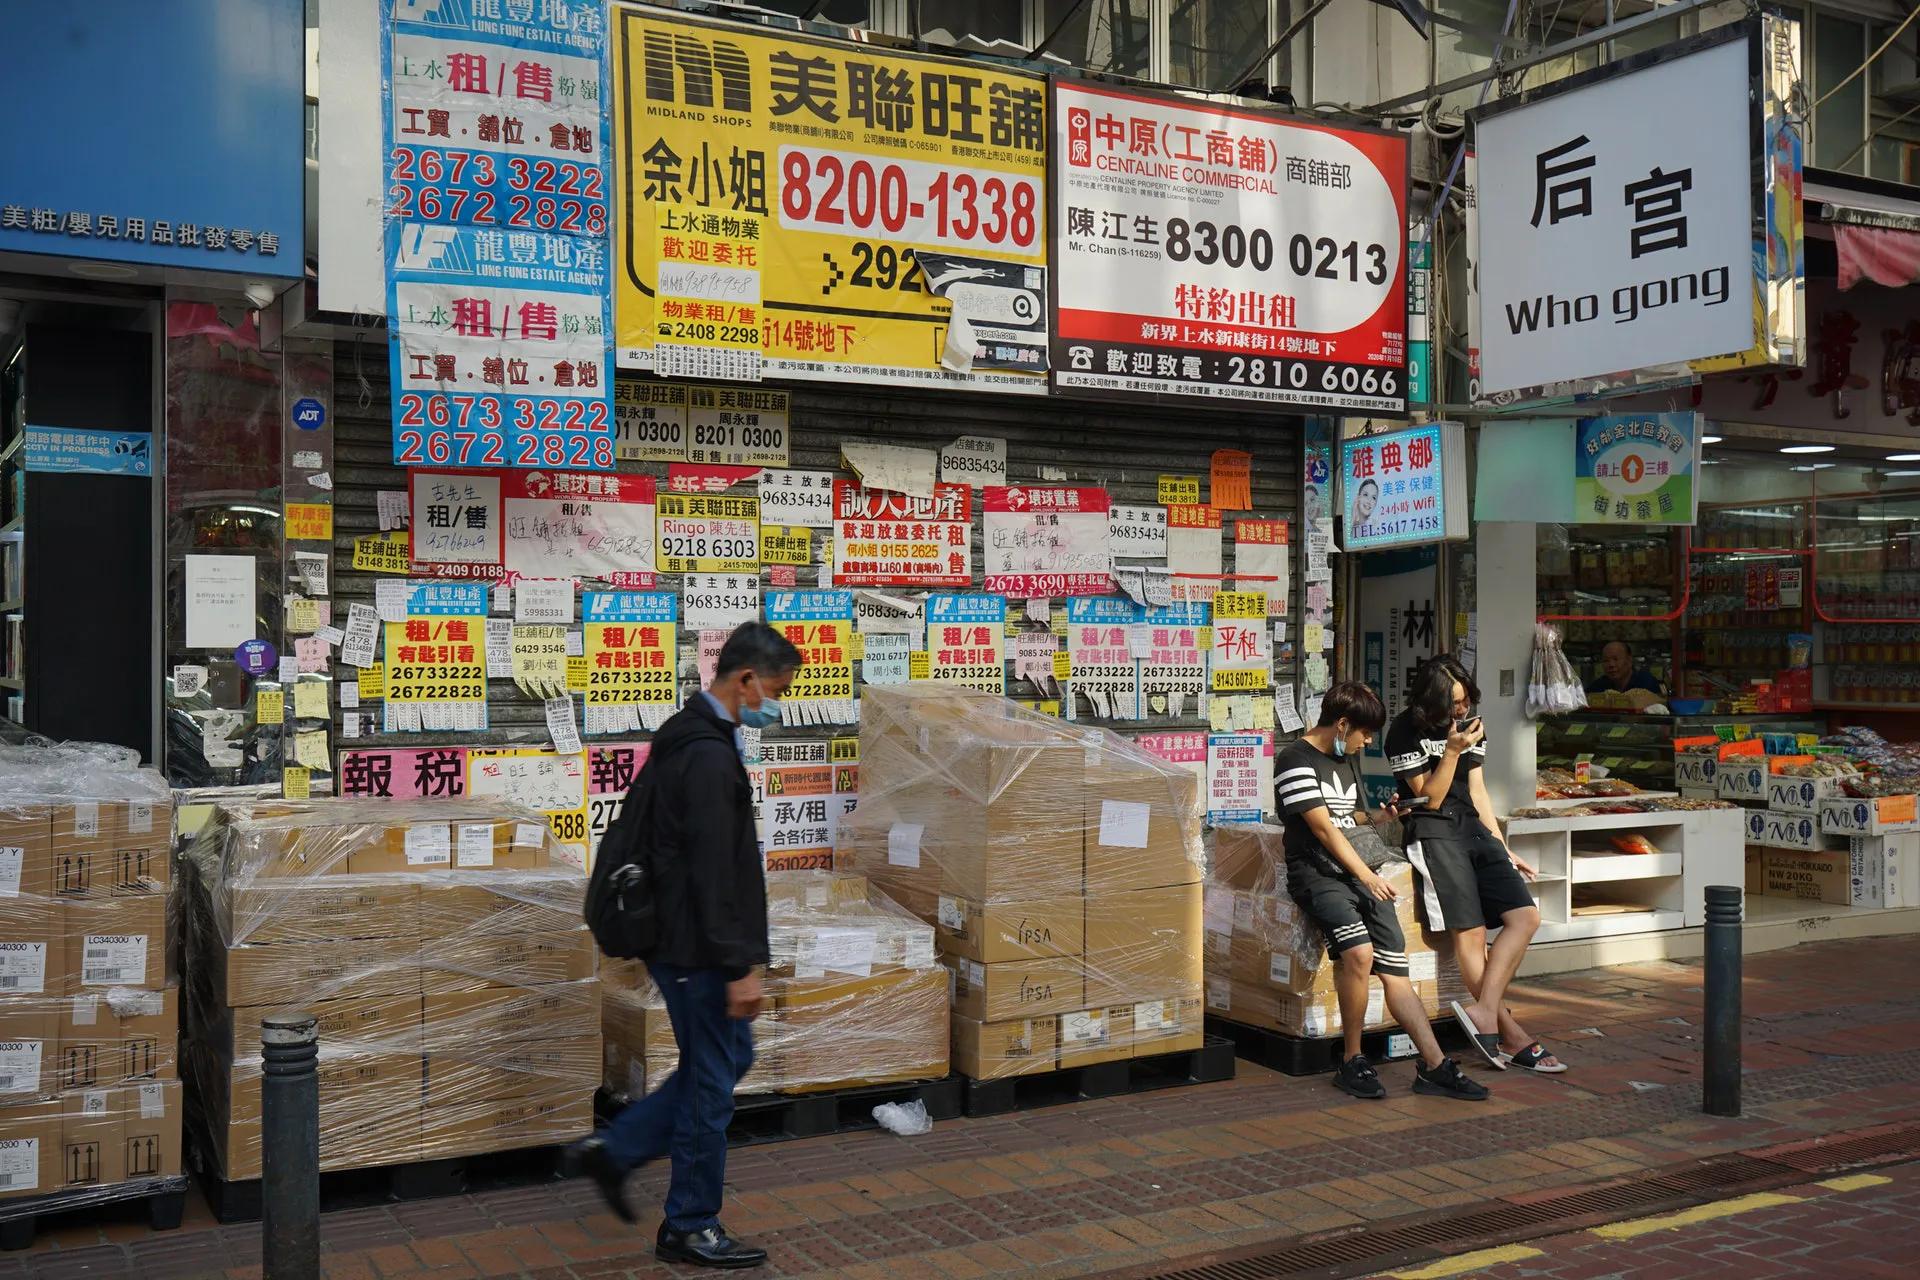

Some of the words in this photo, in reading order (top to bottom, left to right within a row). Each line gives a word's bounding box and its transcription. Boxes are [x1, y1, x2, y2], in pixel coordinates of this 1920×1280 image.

[472, 20, 498, 35] LUNG
[500, 24, 524, 38] FUNG
[526, 27, 562, 44] ESTATE
[564, 35, 601, 49] AGENCY
[647, 106, 705, 122] MIDLAND
[712, 115, 752, 128] SHOPS
[390, 148, 496, 186] 2673
[508, 158, 603, 200] 3222
[642, 136, 768, 217] 余小姐
[1097, 154, 1178, 180] CENTALINE
[1183, 166, 1278, 195] COMMERCIAL
[1100, 175, 1136, 186] CENTALINE
[1137, 180, 1170, 191] PROPERTY
[1172, 185, 1198, 195] AGENCY
[1200, 188, 1224, 198] LIMITED
[781, 151, 1036, 247] 8200-1338
[389, 185, 495, 225] 2672
[509, 195, 606, 235] 2828
[661, 209, 759, 240] 上水通物業
[1068, 206, 1159, 245] 陳江生
[663, 236, 756, 266] 歡迎委托
[1069, 241, 1085, 252] Mr.
[1089, 243, 1117, 255] Chan
[1118, 247, 1161, 260] (S-116259)
[1165, 218, 1274, 272] 8300
[1289, 234, 1387, 287] 0213
[476, 263, 501, 277] LUNG
[503, 266, 528, 279] FUNG
[530, 268, 566, 283] ESTATE
[568, 272, 604, 286] AGENCY
[1174, 282, 1297, 329] 特約出租
[1506, 293, 1599, 335] Who
[1613, 265, 1729, 324] gong
[663, 301, 755, 325] 物業租/售
[676, 323, 715, 340] 2408
[720, 326, 759, 344] 2298
[1228, 357, 1308, 387] 2810
[1322, 366, 1397, 396] 6066
[299, 410, 319, 421] ADT
[400, 393, 501, 428] 2673
[513, 399, 608, 433] 3222
[638, 422, 680, 443] 0300
[695, 424, 735, 445] 8201
[742, 427, 782, 448] 0300
[62, 446, 111, 456] PROGRESS
[399, 431, 503, 465] 2672
[517, 434, 612, 467] 2828
[1352, 436, 1433, 479] 雅典娜
[943, 456, 1005, 473] 96835434
[1597, 462, 1620, 477] 請上
[1645, 461, 1668, 475] 三樓
[1409, 475, 1433, 491] 保健
[762, 490, 831, 508] 96835434
[1160, 495, 1177, 503] 9148
[1178, 495, 1196, 503] 3813
[1413, 496, 1435, 510] Wifi
[663, 521, 705, 537] Ringo
[710, 521, 753, 537] 陳先生
[1411, 515, 1438, 531] 7458
[842, 523, 942, 541] 歡迎放盤委托
[1110, 525, 1165, 541] 96835434
[662, 538, 707, 557] 9218
[712, 539, 755, 558] 6303
[764, 551, 786, 560] 9717
[787, 552, 807, 561] 7686
[847, 544, 878, 557] 何小姐
[881, 545, 908, 557] 9155
[911, 545, 938, 558] 2625
[357, 556, 383, 567] 9148
[385, 558, 409, 570] 3813
[437, 564, 469, 577] 2409
[473, 566, 503, 577] 0188
[724, 561, 758, 569] 2415-7000
[986, 575, 1025, 591] 2673
[1029, 574, 1064, 589] 3690
[686, 595, 757, 610] 96835434
[524, 609, 564, 617] 59985331
[398, 645, 474, 664] 有匙引看
[515, 644, 539, 653] 6429
[542, 644, 565, 653] 3546
[867, 653, 885, 661] 9201
[888, 652, 907, 660] 6717
[937, 648, 995, 665] 有匙引看
[595, 651, 665, 668] 有匙引看
[392, 667, 482, 680] 26733222
[590, 671, 672, 684] 26733222
[934, 667, 1001, 679] 26733222
[1072, 667, 1134, 677] 26733222
[1143, 667, 1203, 677] 26733222
[1216, 673, 1233, 687] 9143
[1234, 672, 1252, 687] 6073
[391, 685, 482, 698] 26722828
[590, 689, 673, 702] 26722828
[1071, 682, 1134, 693] 26722828
[1143, 682, 1203, 693] 26722828
[774, 800, 827, 824] 承/租
[772, 828, 828, 846] 合各行業
[1769, 869, 1785, 879] NW
[1800, 861, 1833, 873] HOKKAIDO
